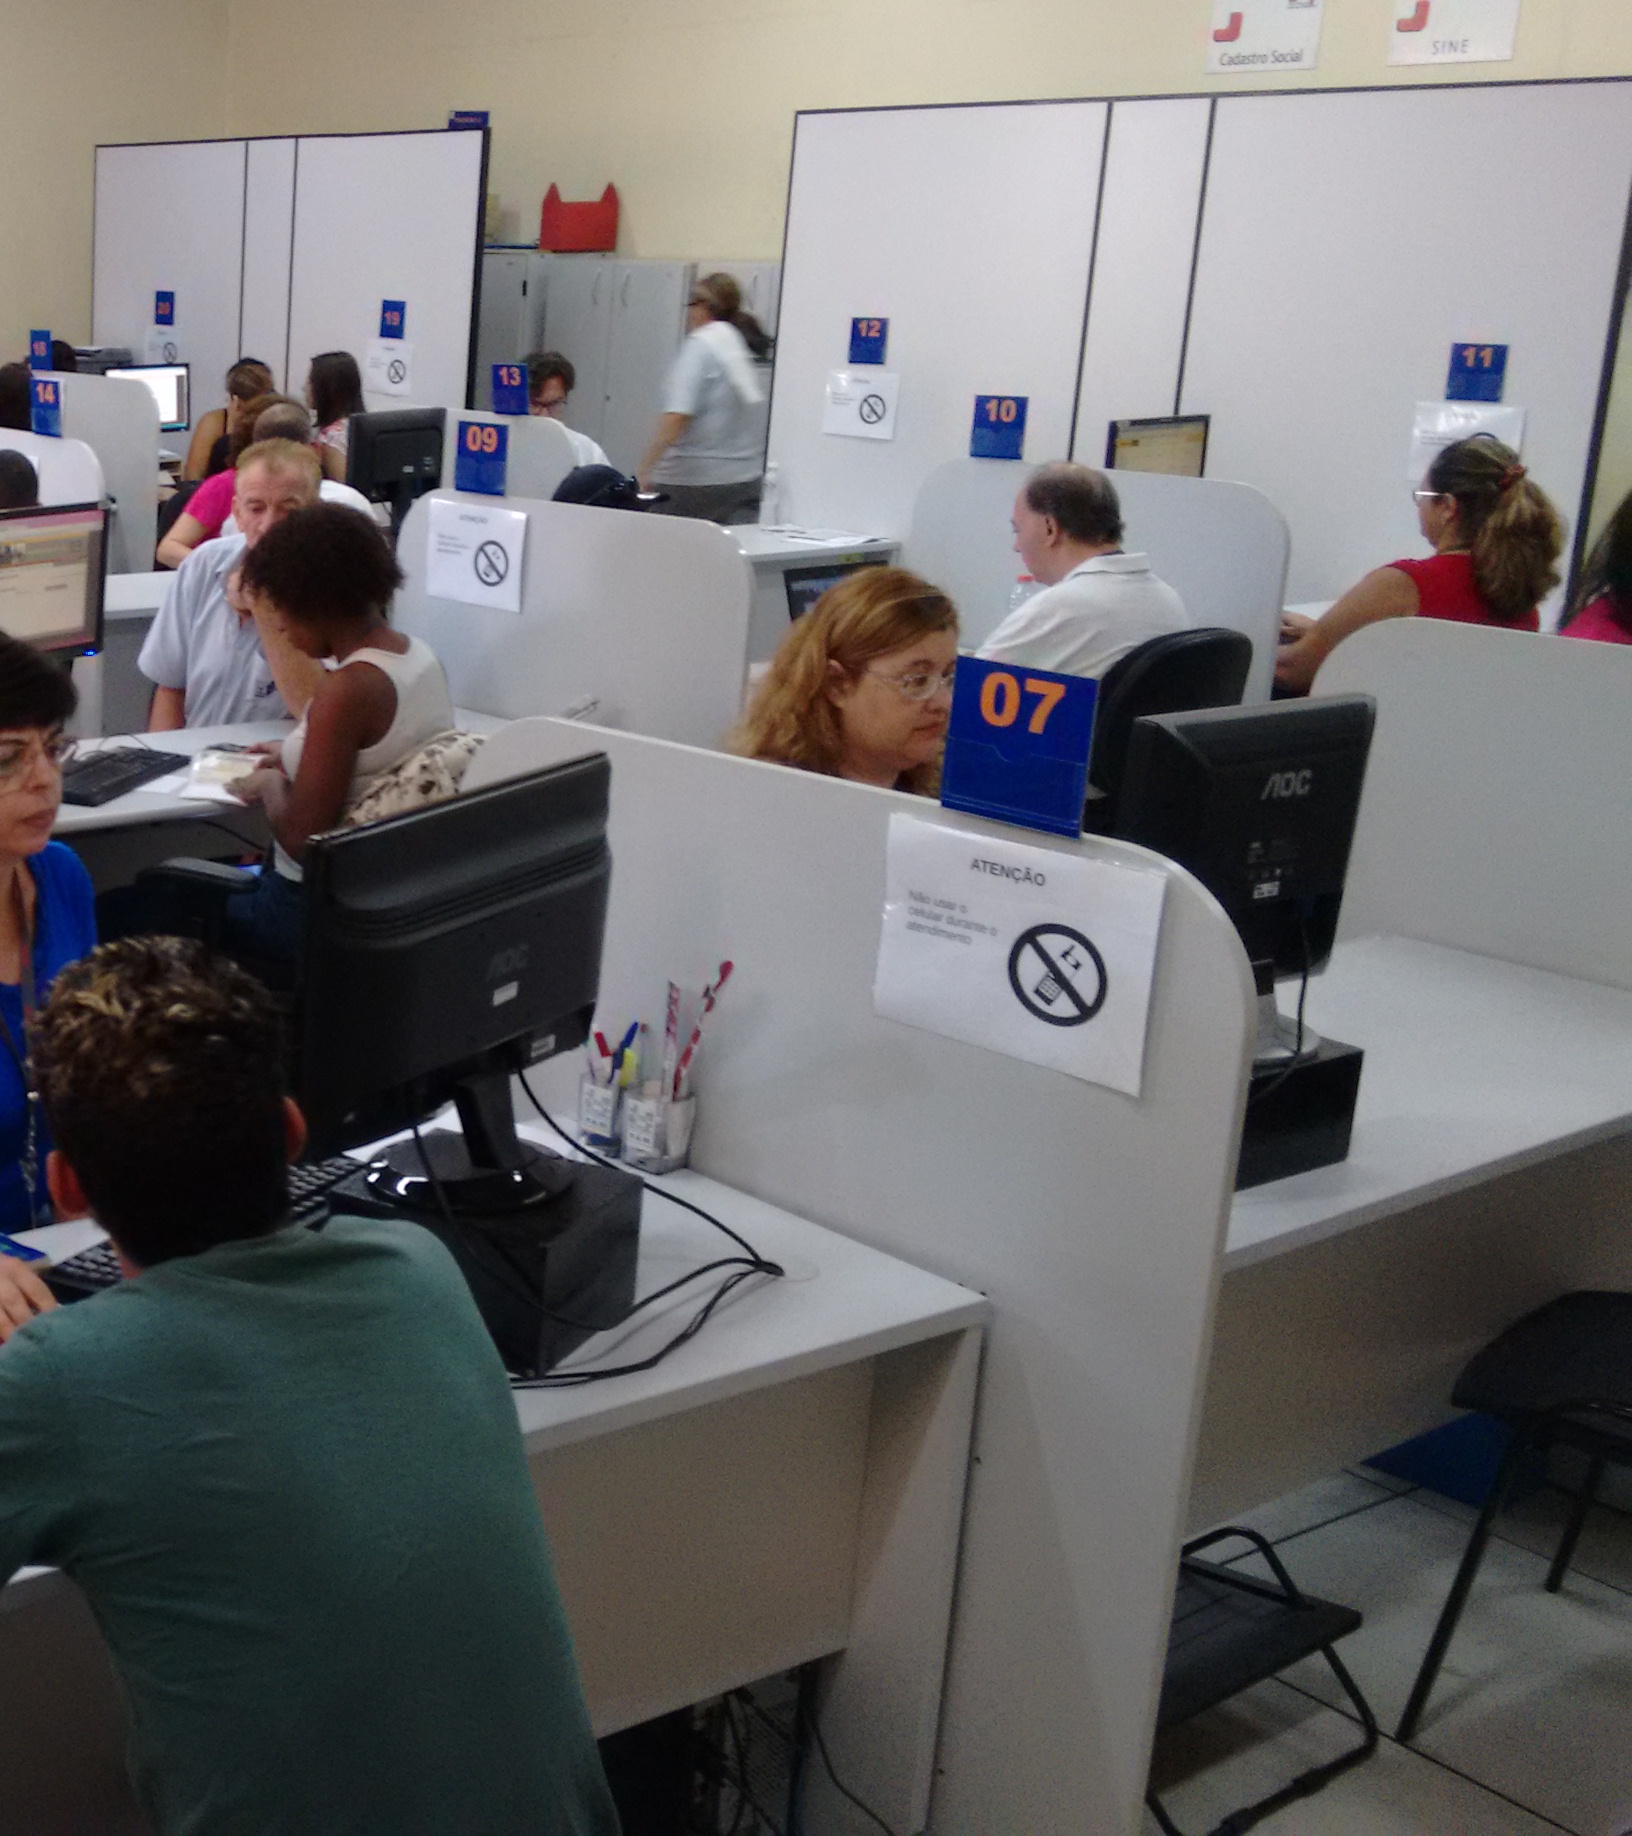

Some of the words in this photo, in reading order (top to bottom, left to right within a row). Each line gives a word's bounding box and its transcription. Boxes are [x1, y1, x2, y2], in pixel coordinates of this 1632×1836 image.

[1219, 51, 1268, 66] Cadastro
[1271, 49, 1303, 63] Social
[1432, 39, 1469, 55] SINE
[858, 319, 881, 338] 12
[1462, 347, 1494, 368] 11
[499, 366, 522, 386] 13
[36, 382, 56, 403] 14
[985, 399, 1017, 423] 10
[466, 425, 499, 453] 09
[979, 670, 1067, 735] 07
[1260, 768, 1313, 800] AOC
[970, 858, 1047, 887] ATENÇÃO
